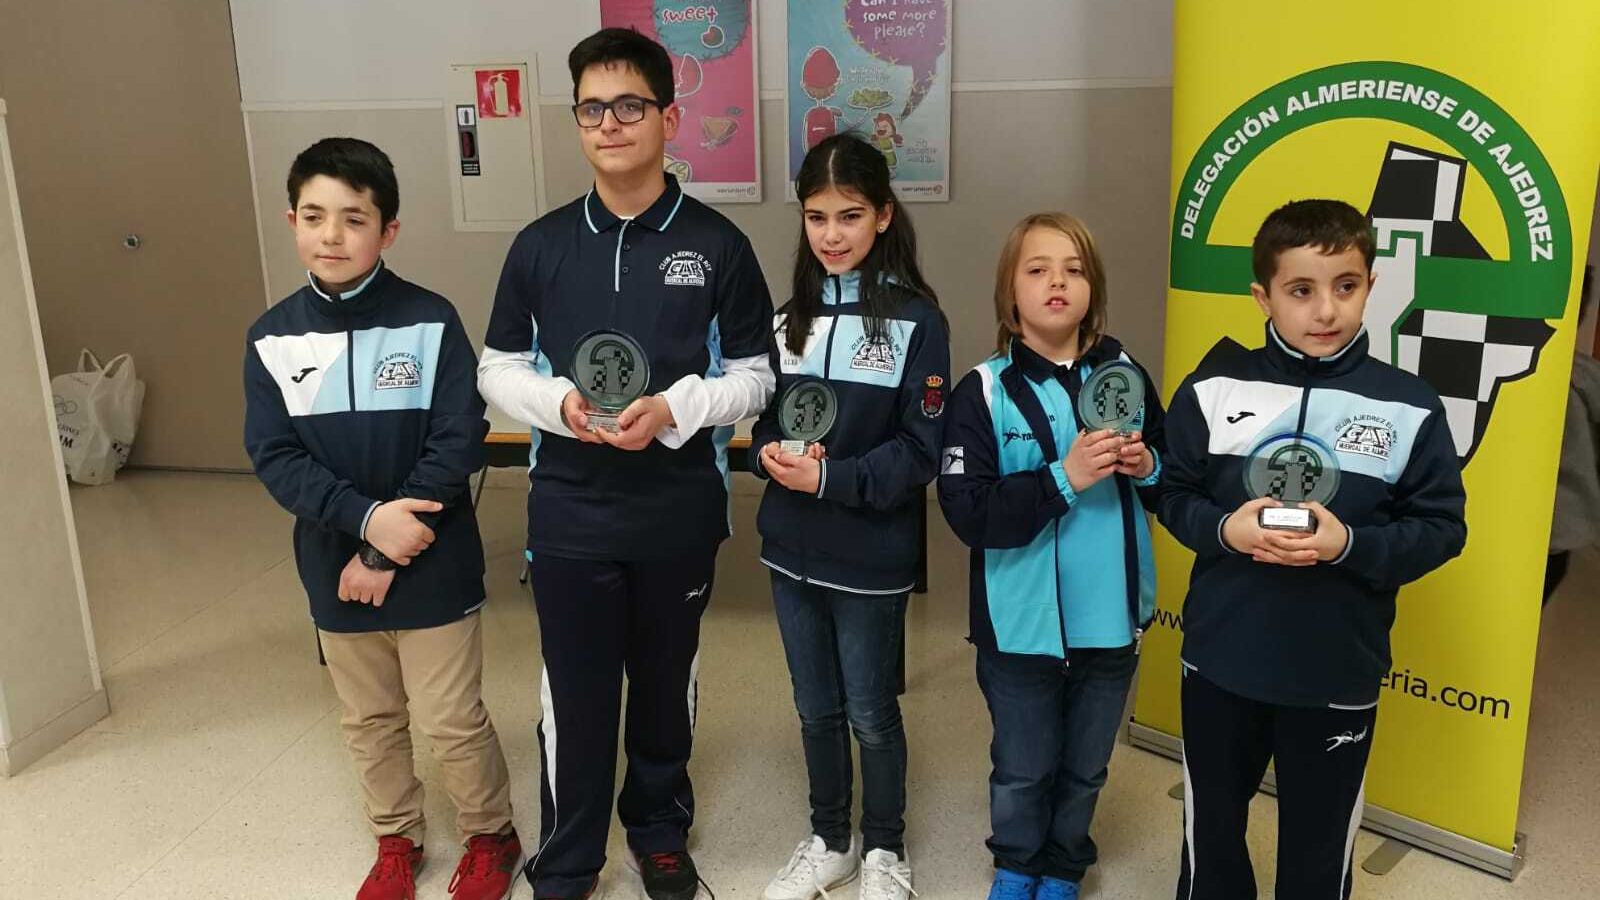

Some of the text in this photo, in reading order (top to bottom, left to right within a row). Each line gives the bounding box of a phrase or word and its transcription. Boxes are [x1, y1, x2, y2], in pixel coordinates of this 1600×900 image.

[662, 5, 718, 24] sweet
[863, 9, 937, 23] some more
[874, 21, 926, 40] please?
[1180, 79, 1553, 263] DELEGACIÓN ALMERIENSE DE AJEDREZ
[1334, 417, 1352, 432] CLUB
[1353, 414, 1386, 425] AJEDREZ
